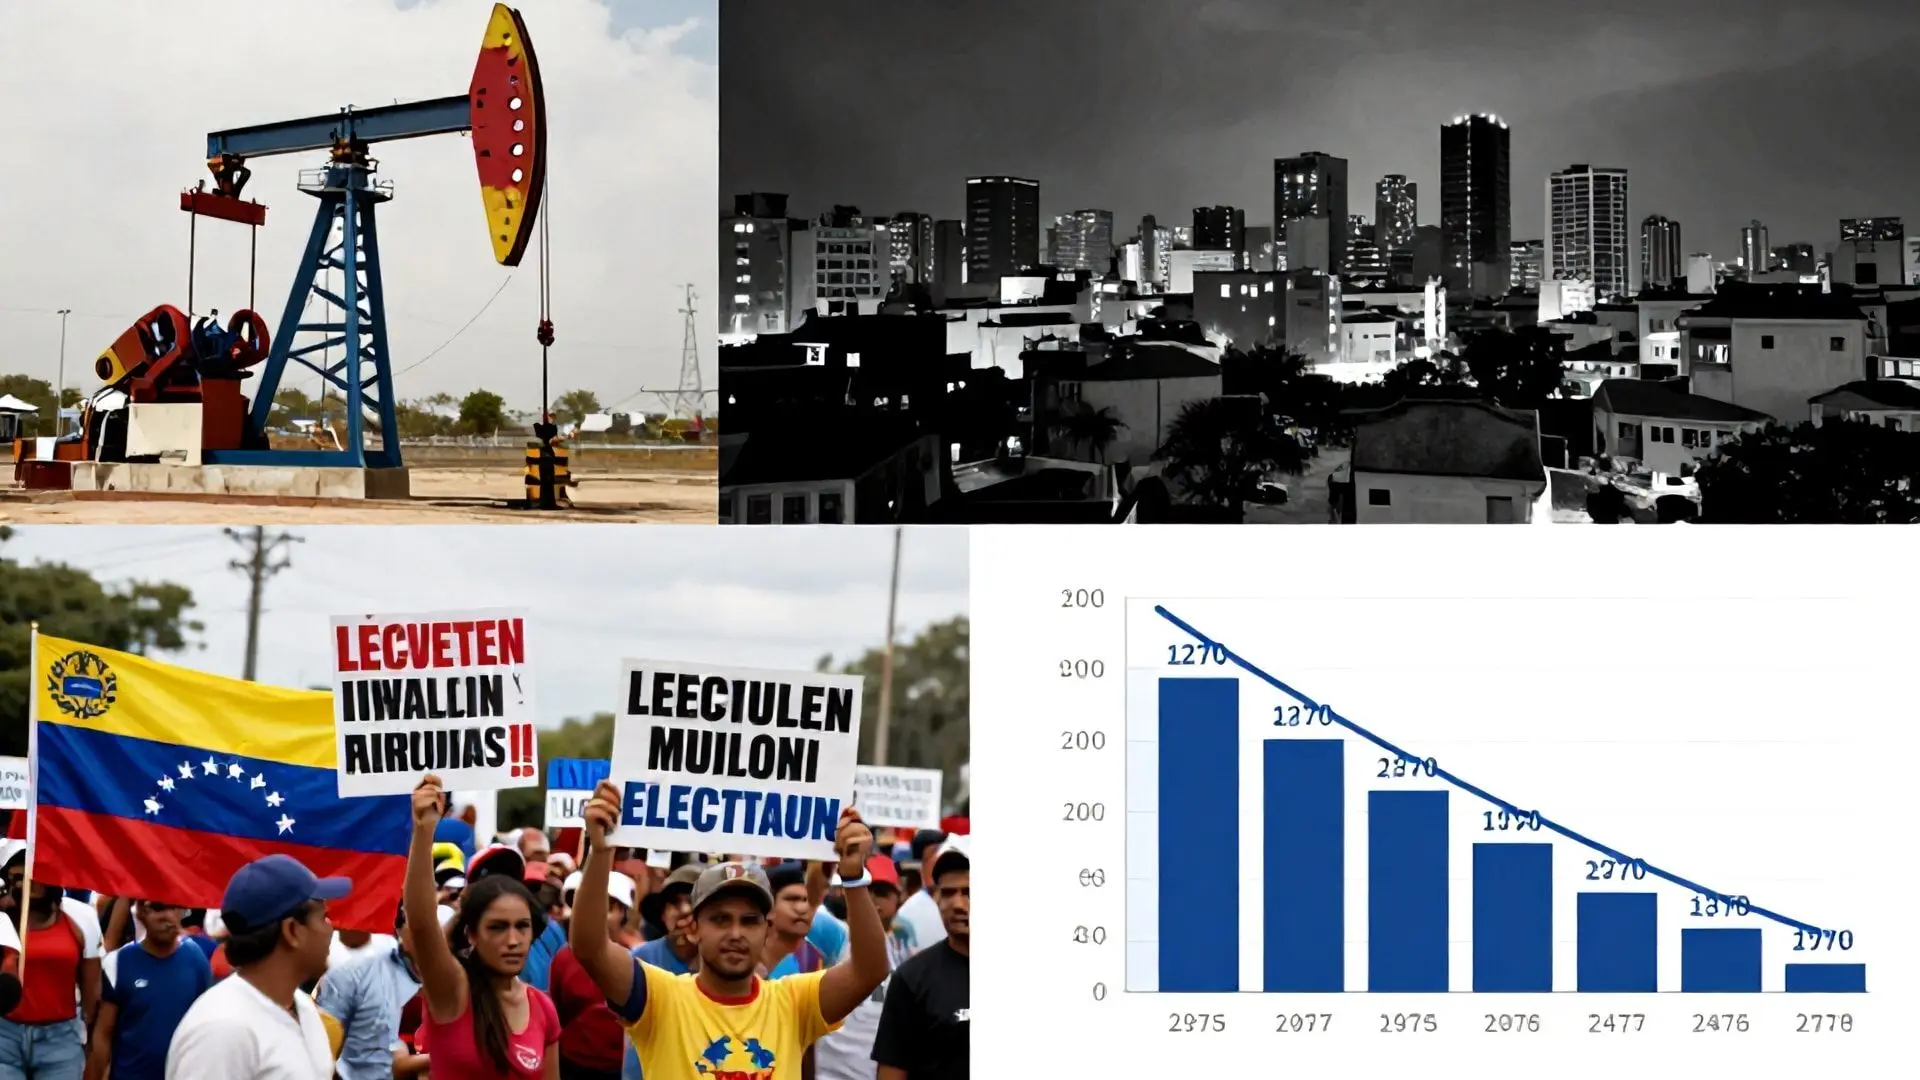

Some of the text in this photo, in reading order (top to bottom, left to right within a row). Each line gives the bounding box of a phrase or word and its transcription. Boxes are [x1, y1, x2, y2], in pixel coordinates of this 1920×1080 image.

[1061, 589, 1105, 609] 200
[336, 618, 525, 672] LECVETEN
[1167, 643, 1226, 665] 1270
[627, 670, 854, 734] LEECIULEN
[1061, 731, 1105, 751] 200
[647, 725, 820, 783] MUILONI
[620, 780, 841, 843] ELECTTAUN
[1062, 802, 1105, 822] 200
[1093, 981, 1107, 1002] 0
[1588, 1013, 1646, 1033] 2477
